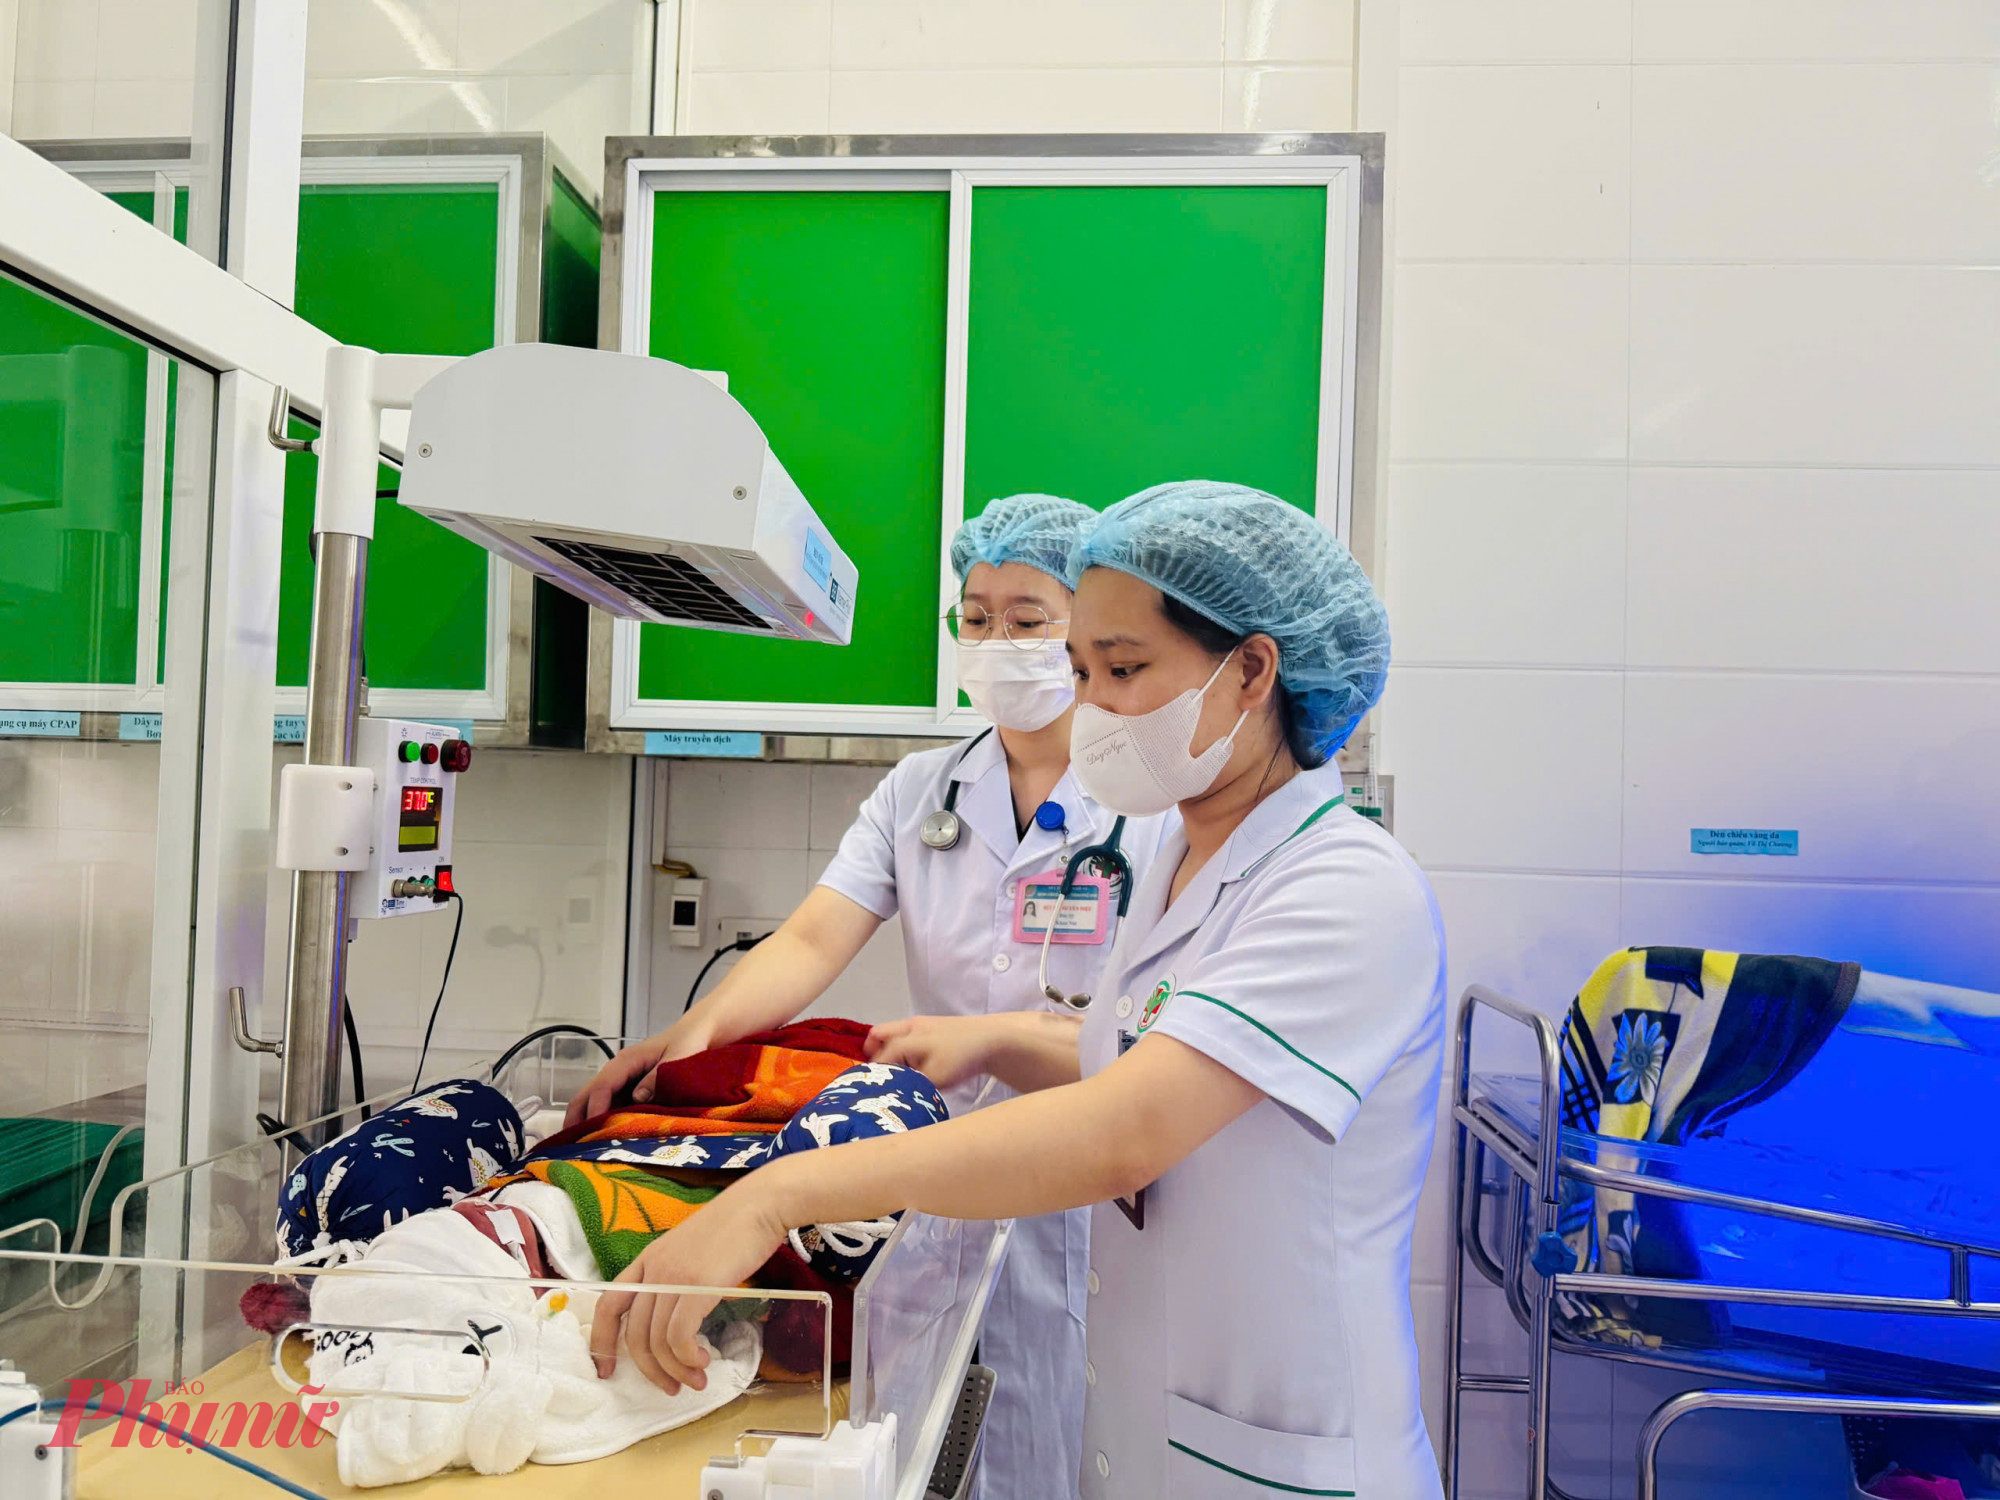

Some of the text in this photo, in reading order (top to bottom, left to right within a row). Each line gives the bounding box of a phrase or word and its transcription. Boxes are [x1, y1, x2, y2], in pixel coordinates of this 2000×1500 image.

[16, 720, 27, 730] cụ
[29, 719, 48, 730] máy
[50, 719, 78, 729] CPAP
[134, 717, 151, 728] Dây
[285, 719, 300, 730] tay
[290, 730, 301, 739] vô
[663, 733, 731, 745] Máy truyền dịch
[388, 866, 404, 874] Sensor
